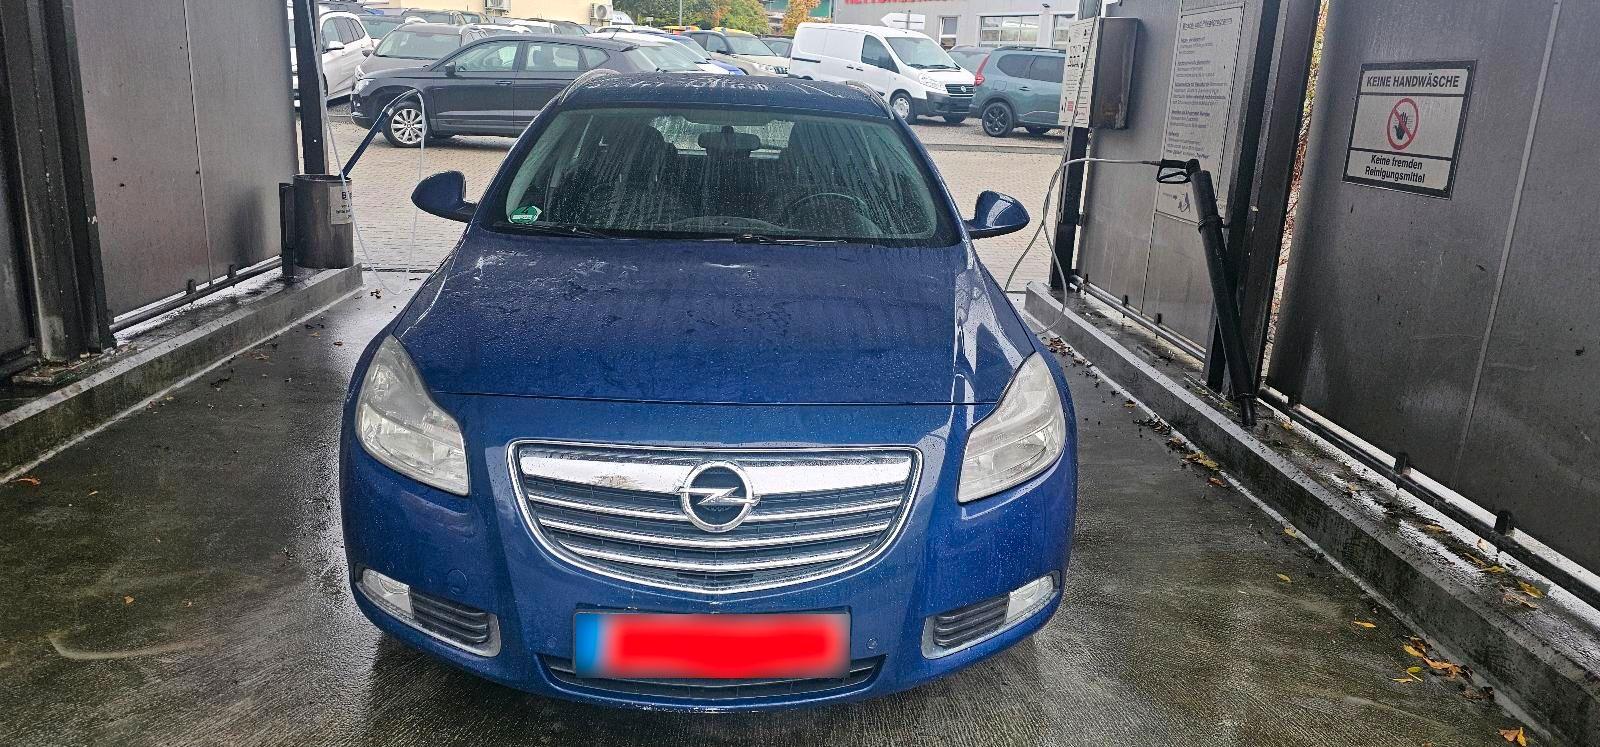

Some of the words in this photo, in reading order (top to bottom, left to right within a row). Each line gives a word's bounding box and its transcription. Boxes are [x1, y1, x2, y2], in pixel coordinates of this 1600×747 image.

[1366, 76, 1391, 87] KEINE
[1392, 73, 1460, 88] HANDWÄSCHE
[1371, 155, 1390, 166] Keine
[1391, 157, 1423, 170] fremden
[1365, 166, 1426, 184] Reinigungsmittel
